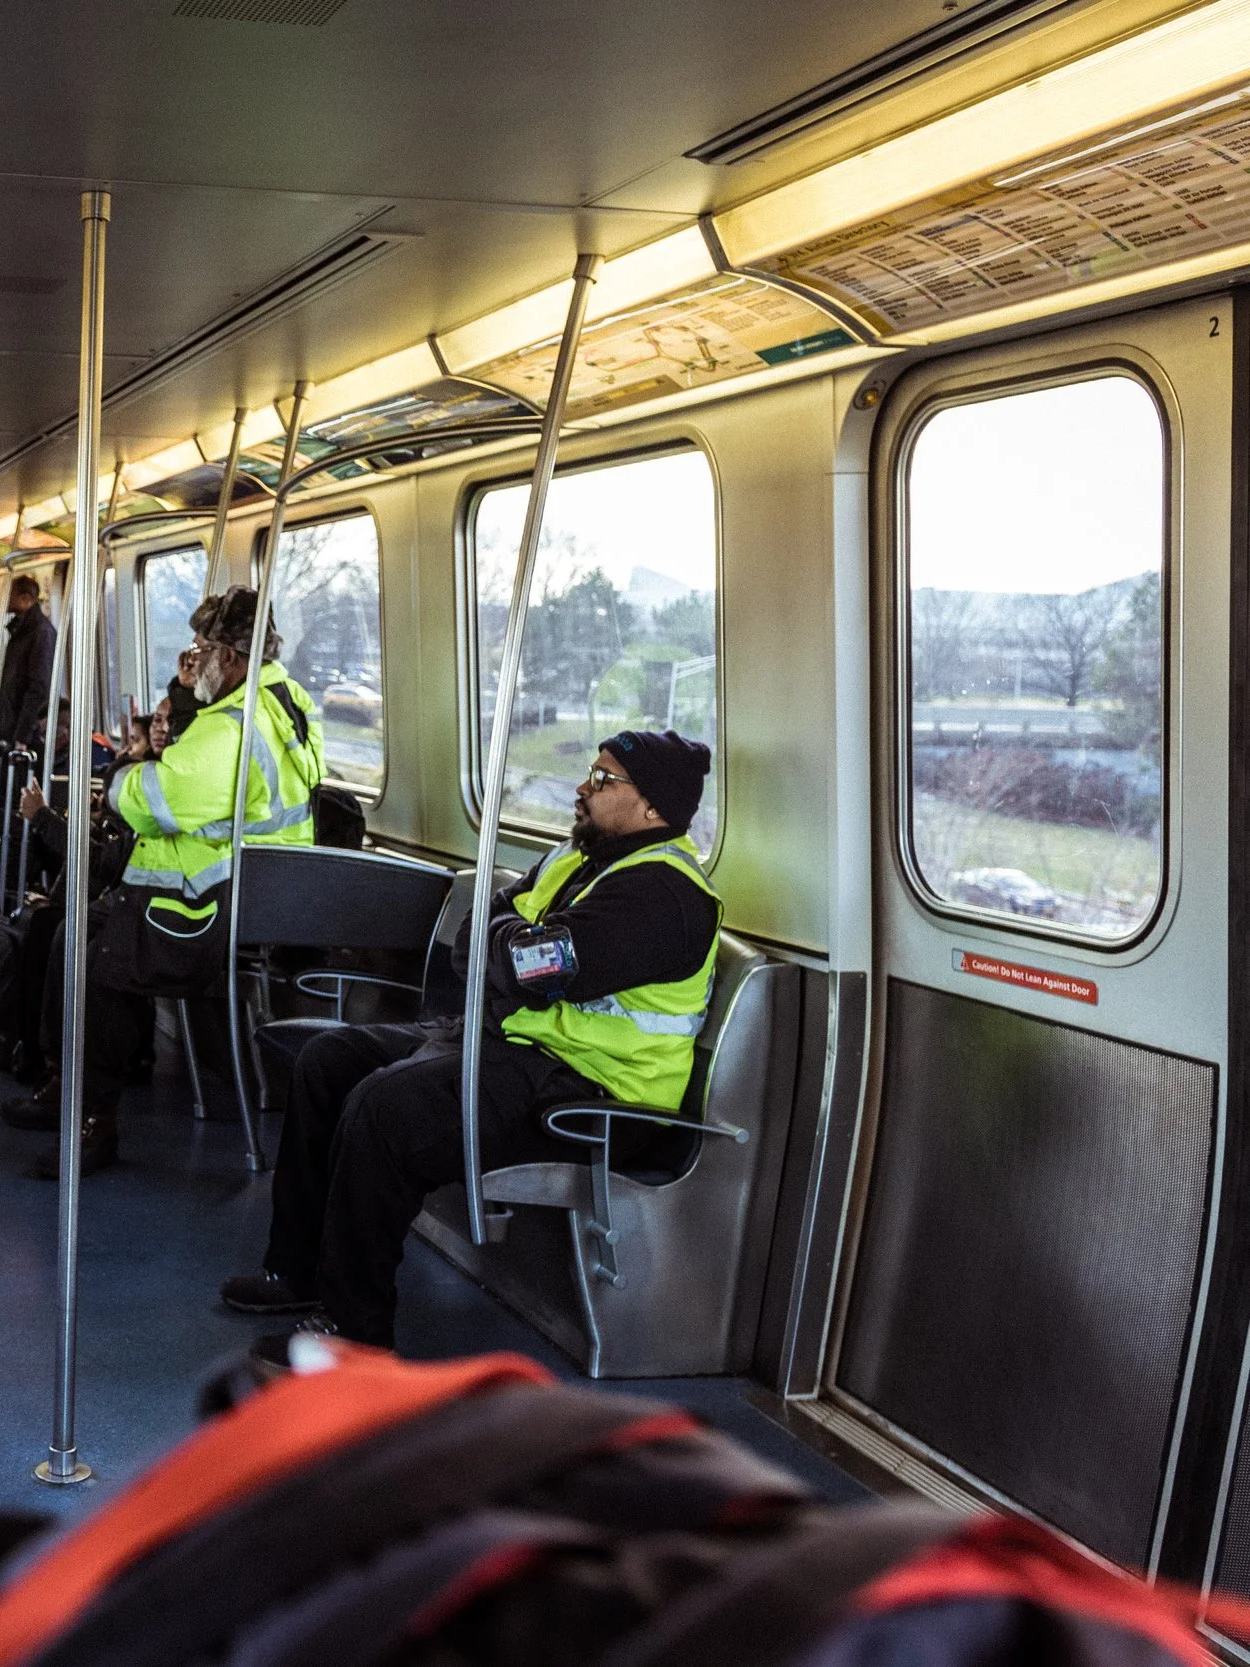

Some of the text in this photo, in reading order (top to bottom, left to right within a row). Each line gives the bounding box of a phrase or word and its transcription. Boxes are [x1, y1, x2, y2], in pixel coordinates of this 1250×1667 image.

[1209, 316, 1220, 338] 2
[972, 959, 1090, 996] Caution! Do Not Lean Against Door
